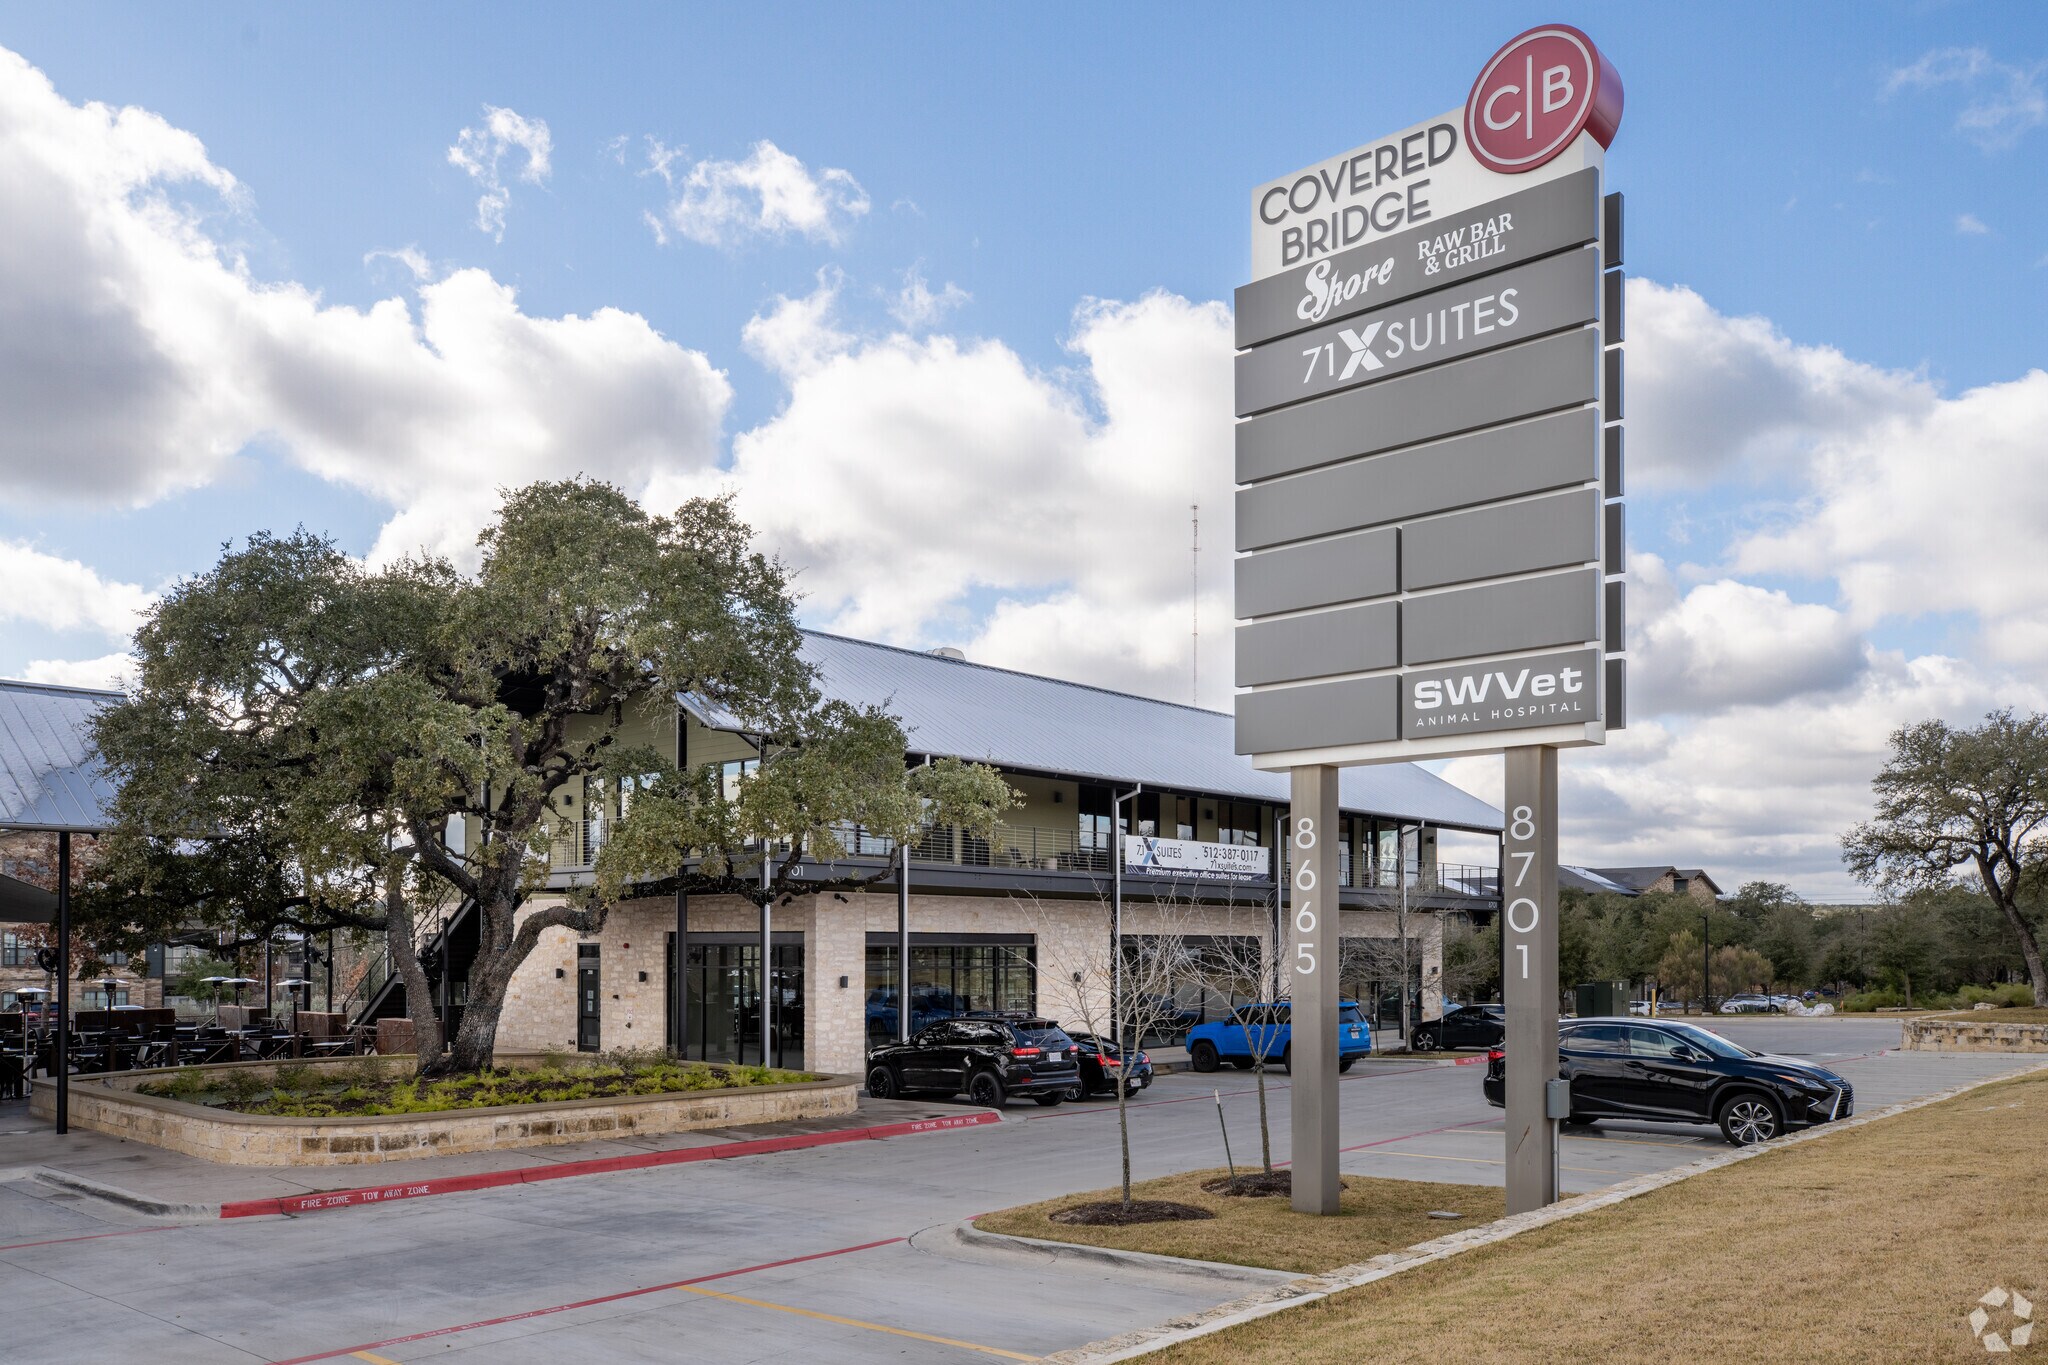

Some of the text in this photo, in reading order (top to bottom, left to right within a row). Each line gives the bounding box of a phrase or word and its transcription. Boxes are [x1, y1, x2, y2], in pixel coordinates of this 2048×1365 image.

[1259, 123, 1458, 226] COVERED
[1281, 178, 1432, 268] BRIDGE
[1417, 213, 1514, 261] RAW BAR
[1424, 238, 1506, 277] & GRILL
[1296, 257, 1396, 323] Shore
[1414, 667, 1583, 710] SWVet
[1416, 701, 1582, 727] ANIMAL HOSPITAL
[1145, 867, 1172, 877] Premium
[1199, 870, 1216, 879] office
[1507, 805, 1539, 979] 8701
[1295, 817, 1317, 975] 8665
[924, 1121, 937, 1129] ZONE
[301, 1185, 430, 1209] FIRE ZONE TOW AWAY ZONE
